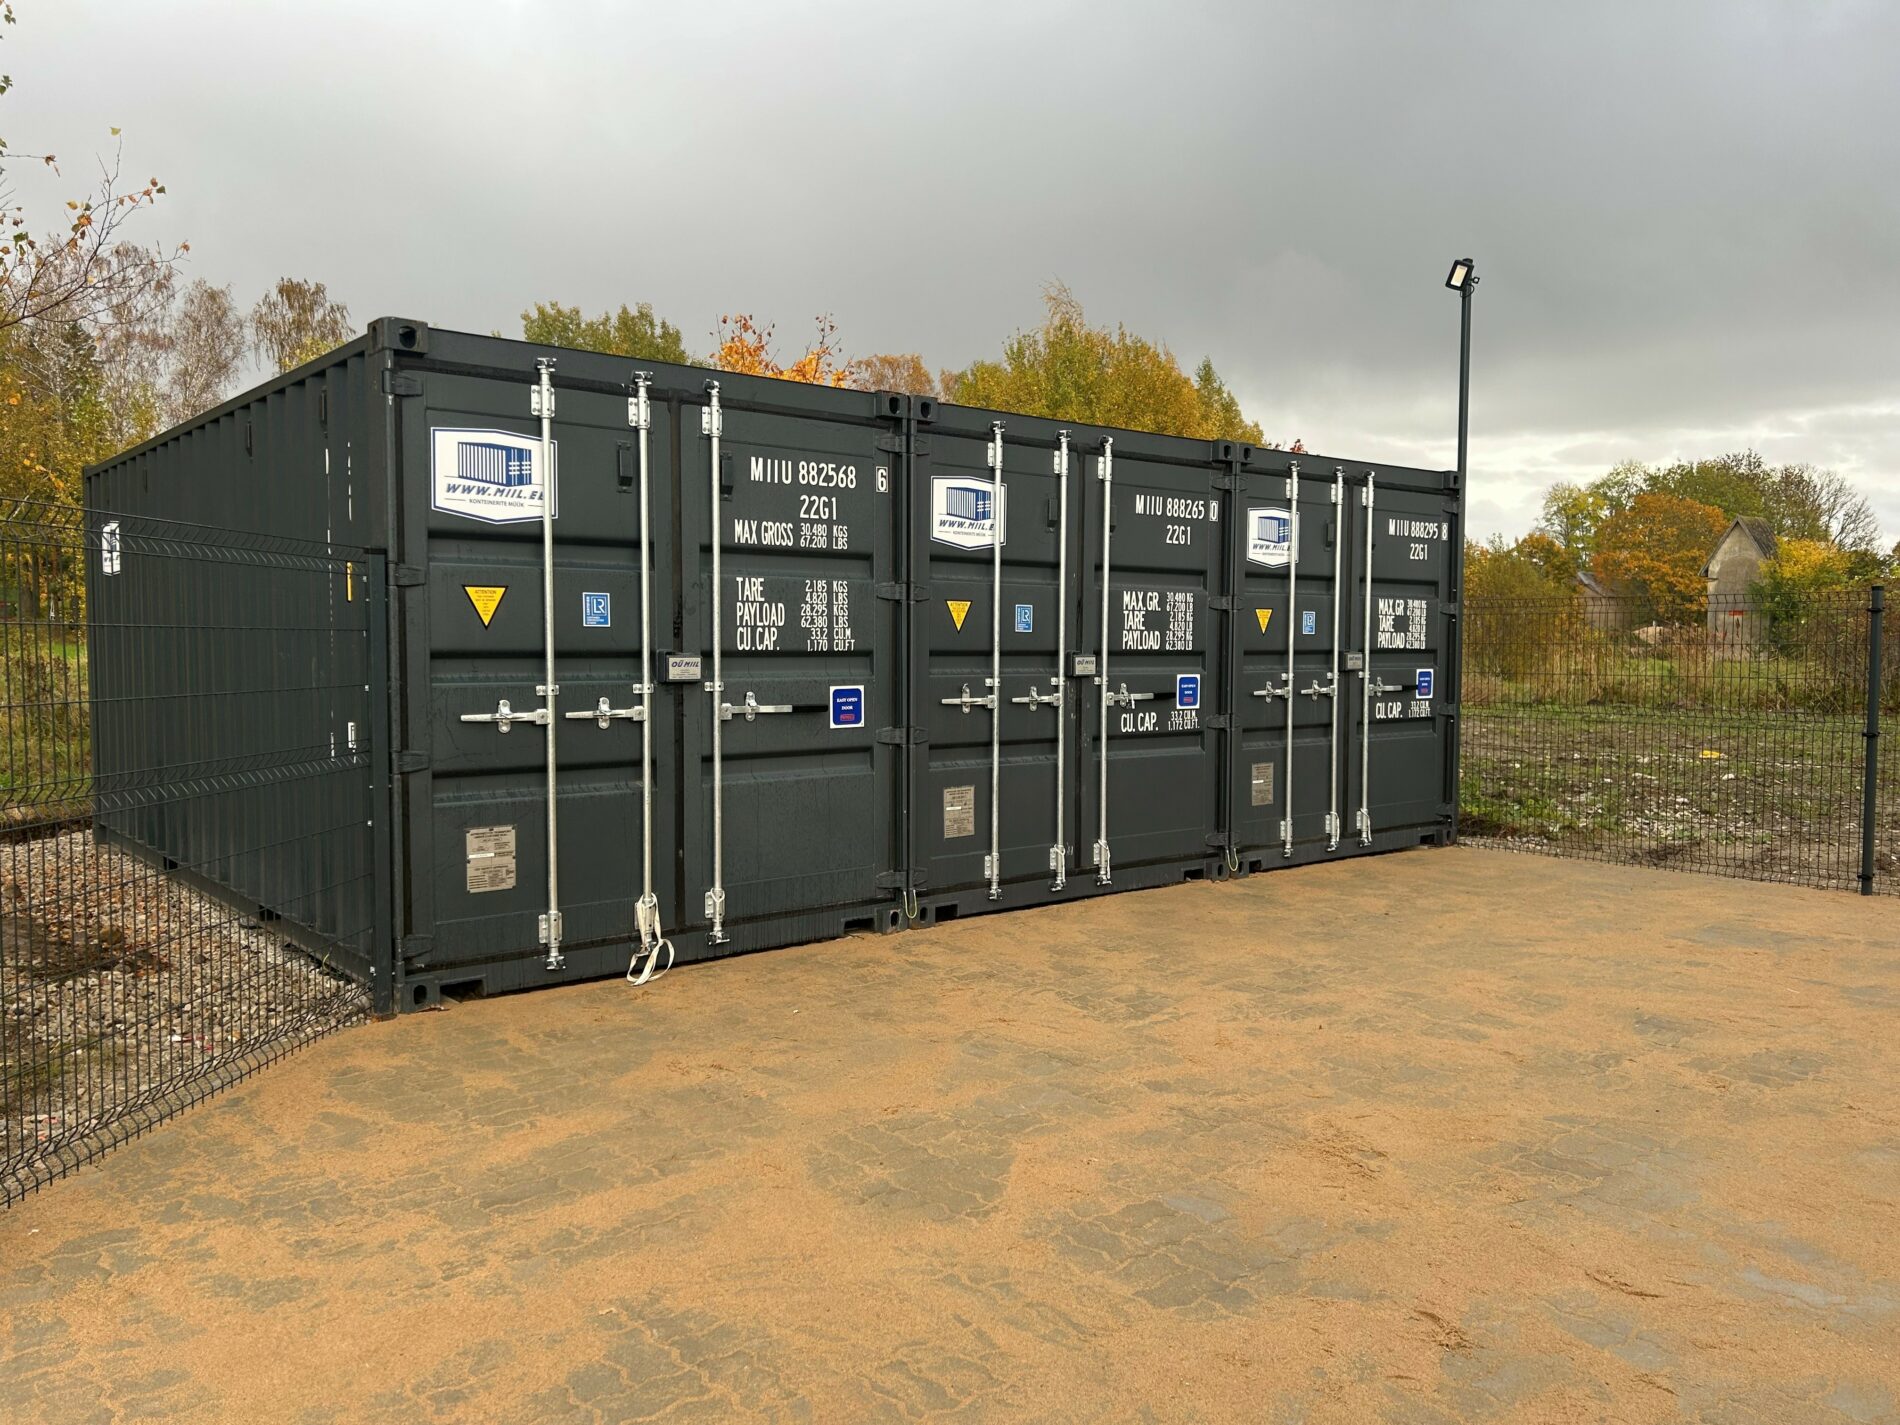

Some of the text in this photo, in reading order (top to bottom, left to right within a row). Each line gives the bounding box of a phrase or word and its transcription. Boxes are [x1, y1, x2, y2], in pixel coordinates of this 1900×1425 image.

[750, 456, 888, 491] MIIU 882568 6
[800, 495, 837, 520] 22G1
[1135, 494, 1163, 516] MIIU
[1166, 497, 1205, 520] 888265
[734, 519, 848, 546] MAX GROSS 30.480 KGS
[939, 519, 994, 531] WWW.MIIL.E
[1388, 518, 1410, 537] MIIU
[1410, 520, 1439, 540] 888295
[800, 535, 848, 550] 67.200 LBS
[1166, 524, 1191, 545] 22G1
[1409, 543, 1428, 561] 22G1
[736, 577, 848, 601] TARE 2.185 KGS
[593, 598, 605, 614] LR
[805, 592, 848, 604] 4.820 LBS
[1123, 590, 1161, 611] MAX.GR.
[1186, 592, 1194, 603] KG
[736, 602, 849, 627] PAYLOAD 28.295 KGS
[1186, 602, 1194, 612] LB
[800, 615, 849, 628] 62.380 LBS
[1123, 610, 1194, 631] TARE 2.185 KG
[1186, 621, 1193, 631] LB
[1378, 615, 1395, 632] TARE
[810, 628, 828, 640] 33.2
[833, 627, 851, 640] CU.M
[1122, 630, 1193, 650] PAYLOAD 28.295 KG
[1377, 631, 1405, 649] PAYLOAD
[807, 639, 856, 652] 1.170 CU.FT
[1165, 640, 1193, 651] 62.380 LB
[671, 659, 683, 668] OÜ
[1170, 710, 1183, 721] 33.2
[1168, 720, 1183, 731] 1.172
